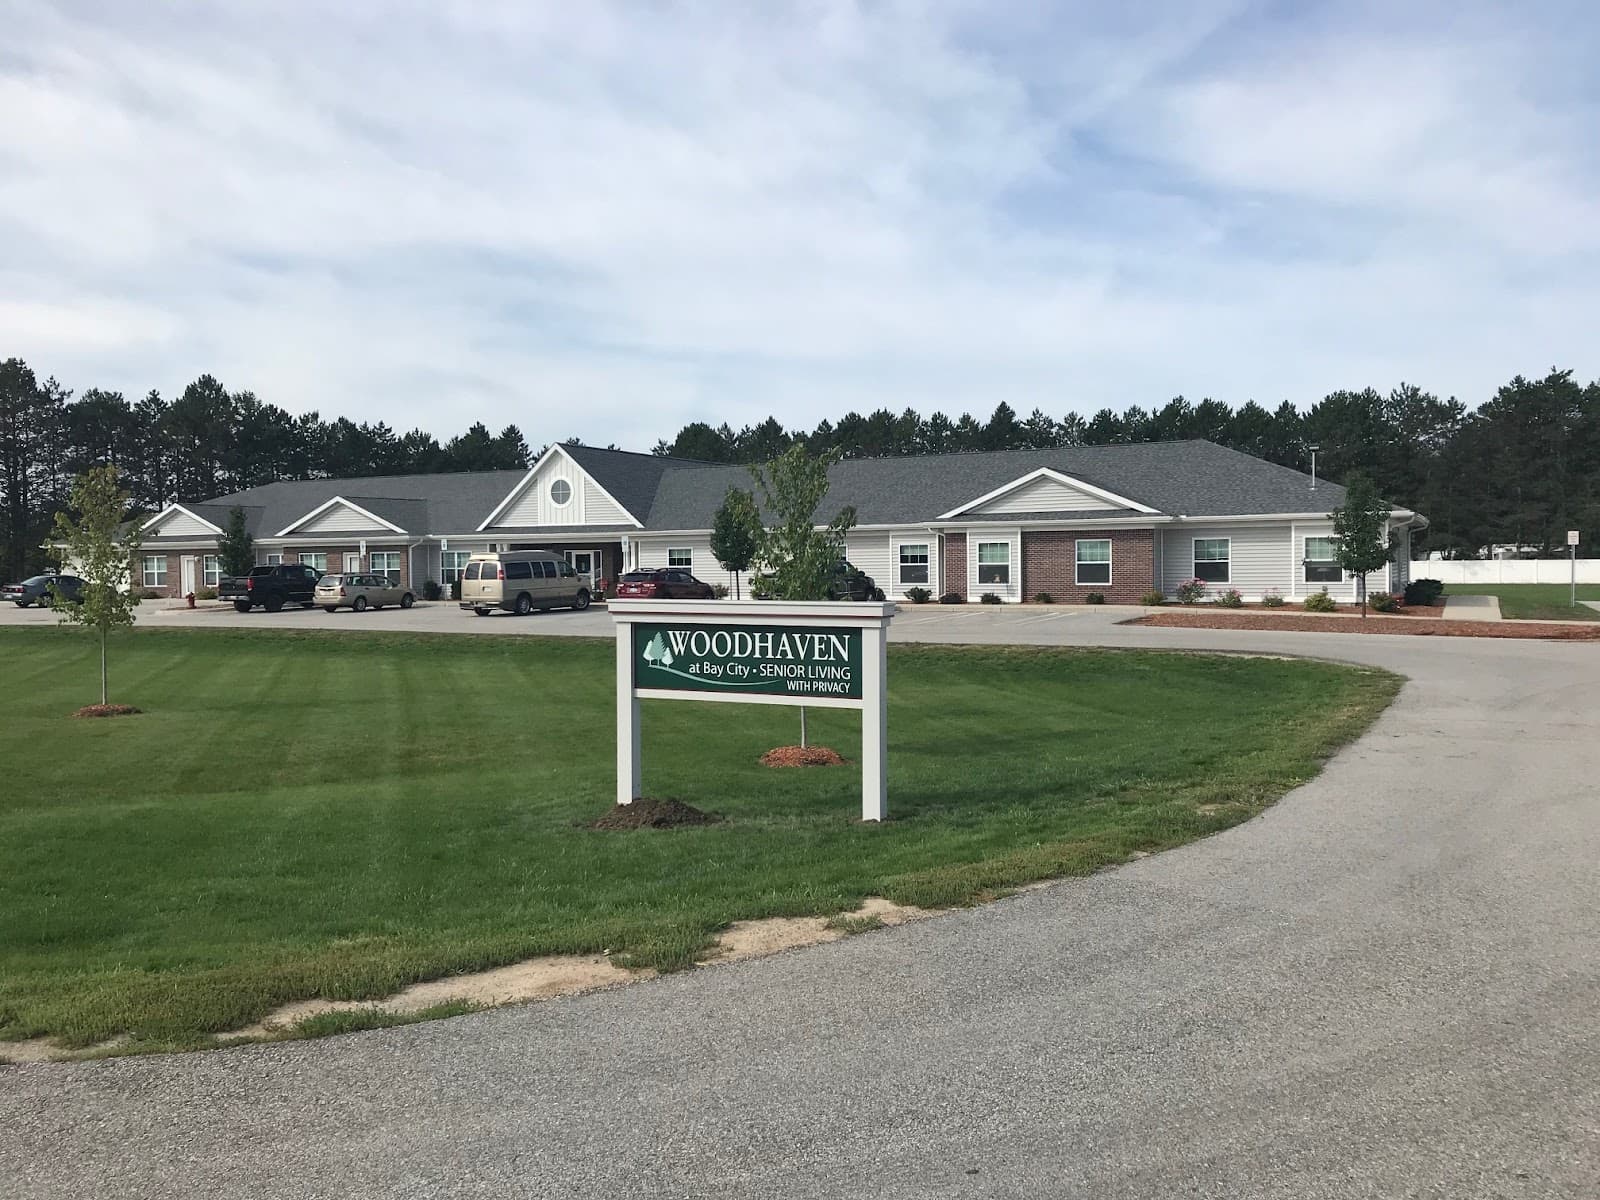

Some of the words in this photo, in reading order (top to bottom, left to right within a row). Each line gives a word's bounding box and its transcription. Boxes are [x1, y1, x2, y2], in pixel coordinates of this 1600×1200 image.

[668, 630, 850, 661] WOODHAVEN
[689, 662, 700, 674] at
[703, 662, 724, 678] Bay
[726, 663, 750, 679] City
[759, 664, 806, 678] SENIOR
[808, 666, 851, 680] LIVING
[786, 680, 811, 691] WITH
[812, 681, 851, 694] PRIVACY
